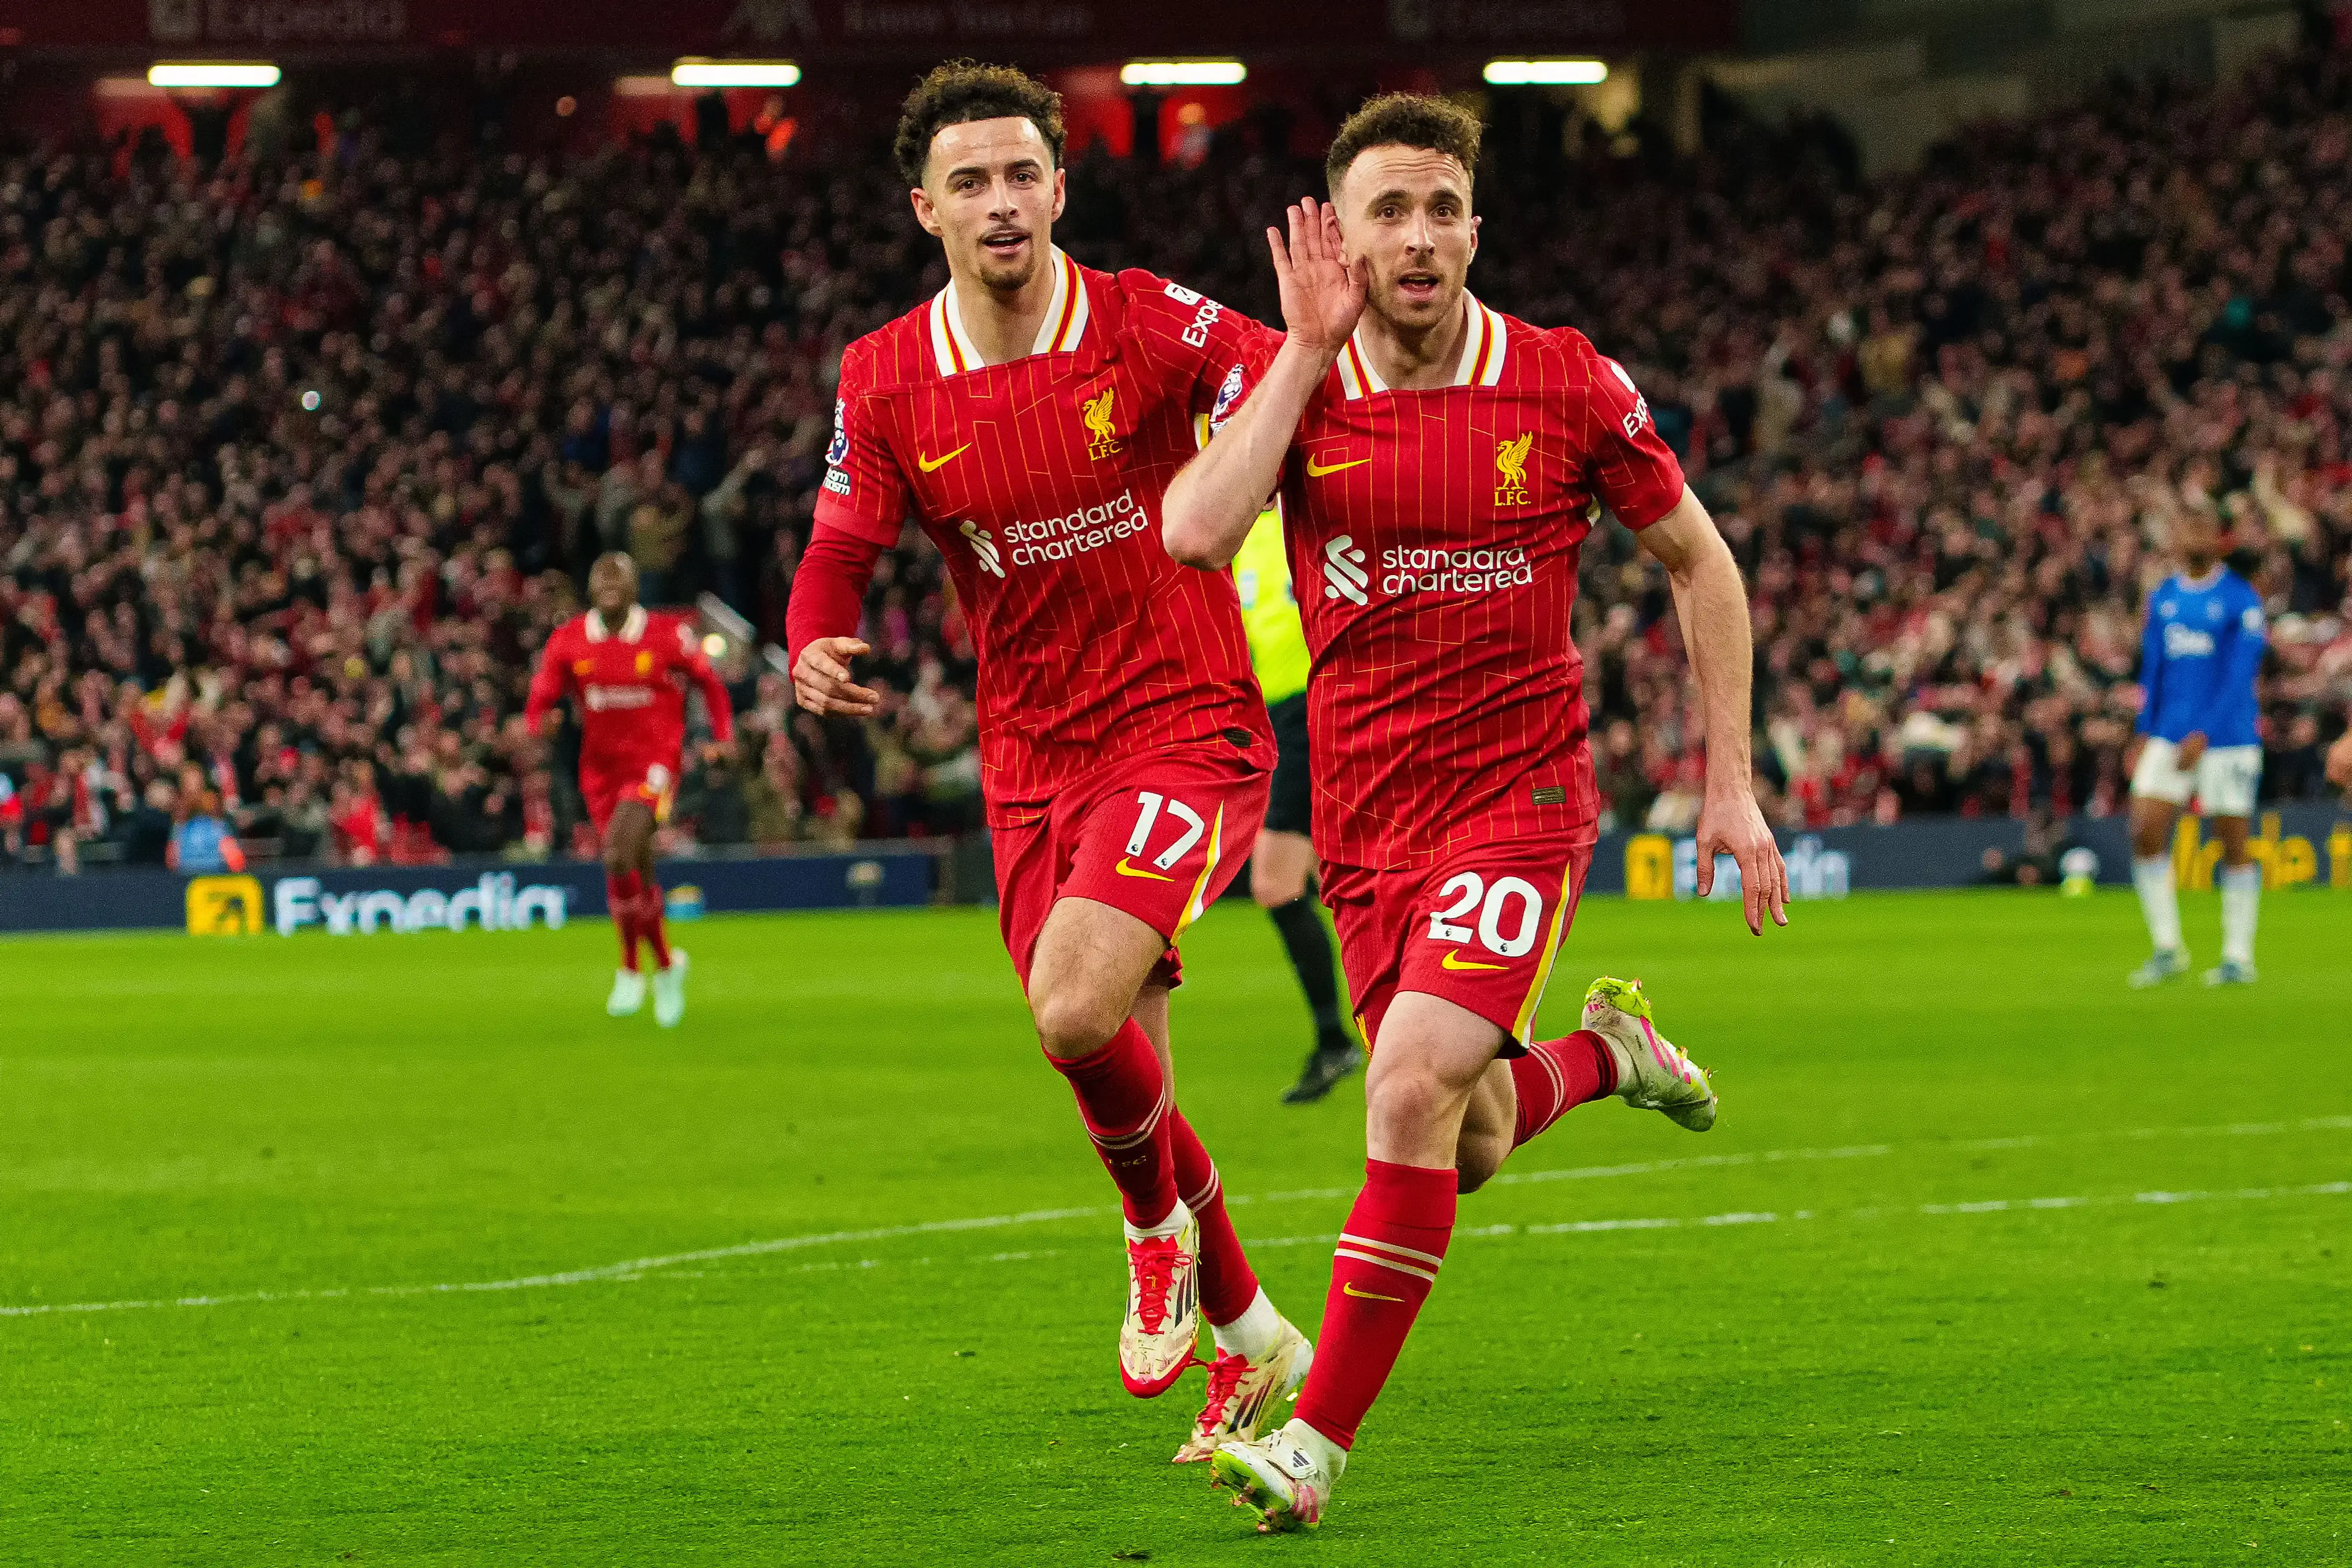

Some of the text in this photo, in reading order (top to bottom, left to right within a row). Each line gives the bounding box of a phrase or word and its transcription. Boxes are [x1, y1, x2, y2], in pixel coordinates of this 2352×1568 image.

[1004, 488, 1134, 543] standard
[1494, 491, 1531, 506] L.F.C.
[1012, 505, 1148, 566] chartered
[1382, 545, 1525, 570] standard
[1382, 561, 1532, 594] chartered
[1125, 791, 1205, 870] 17
[274, 872, 567, 937] Expedia
[1426, 871, 1544, 957] 20
